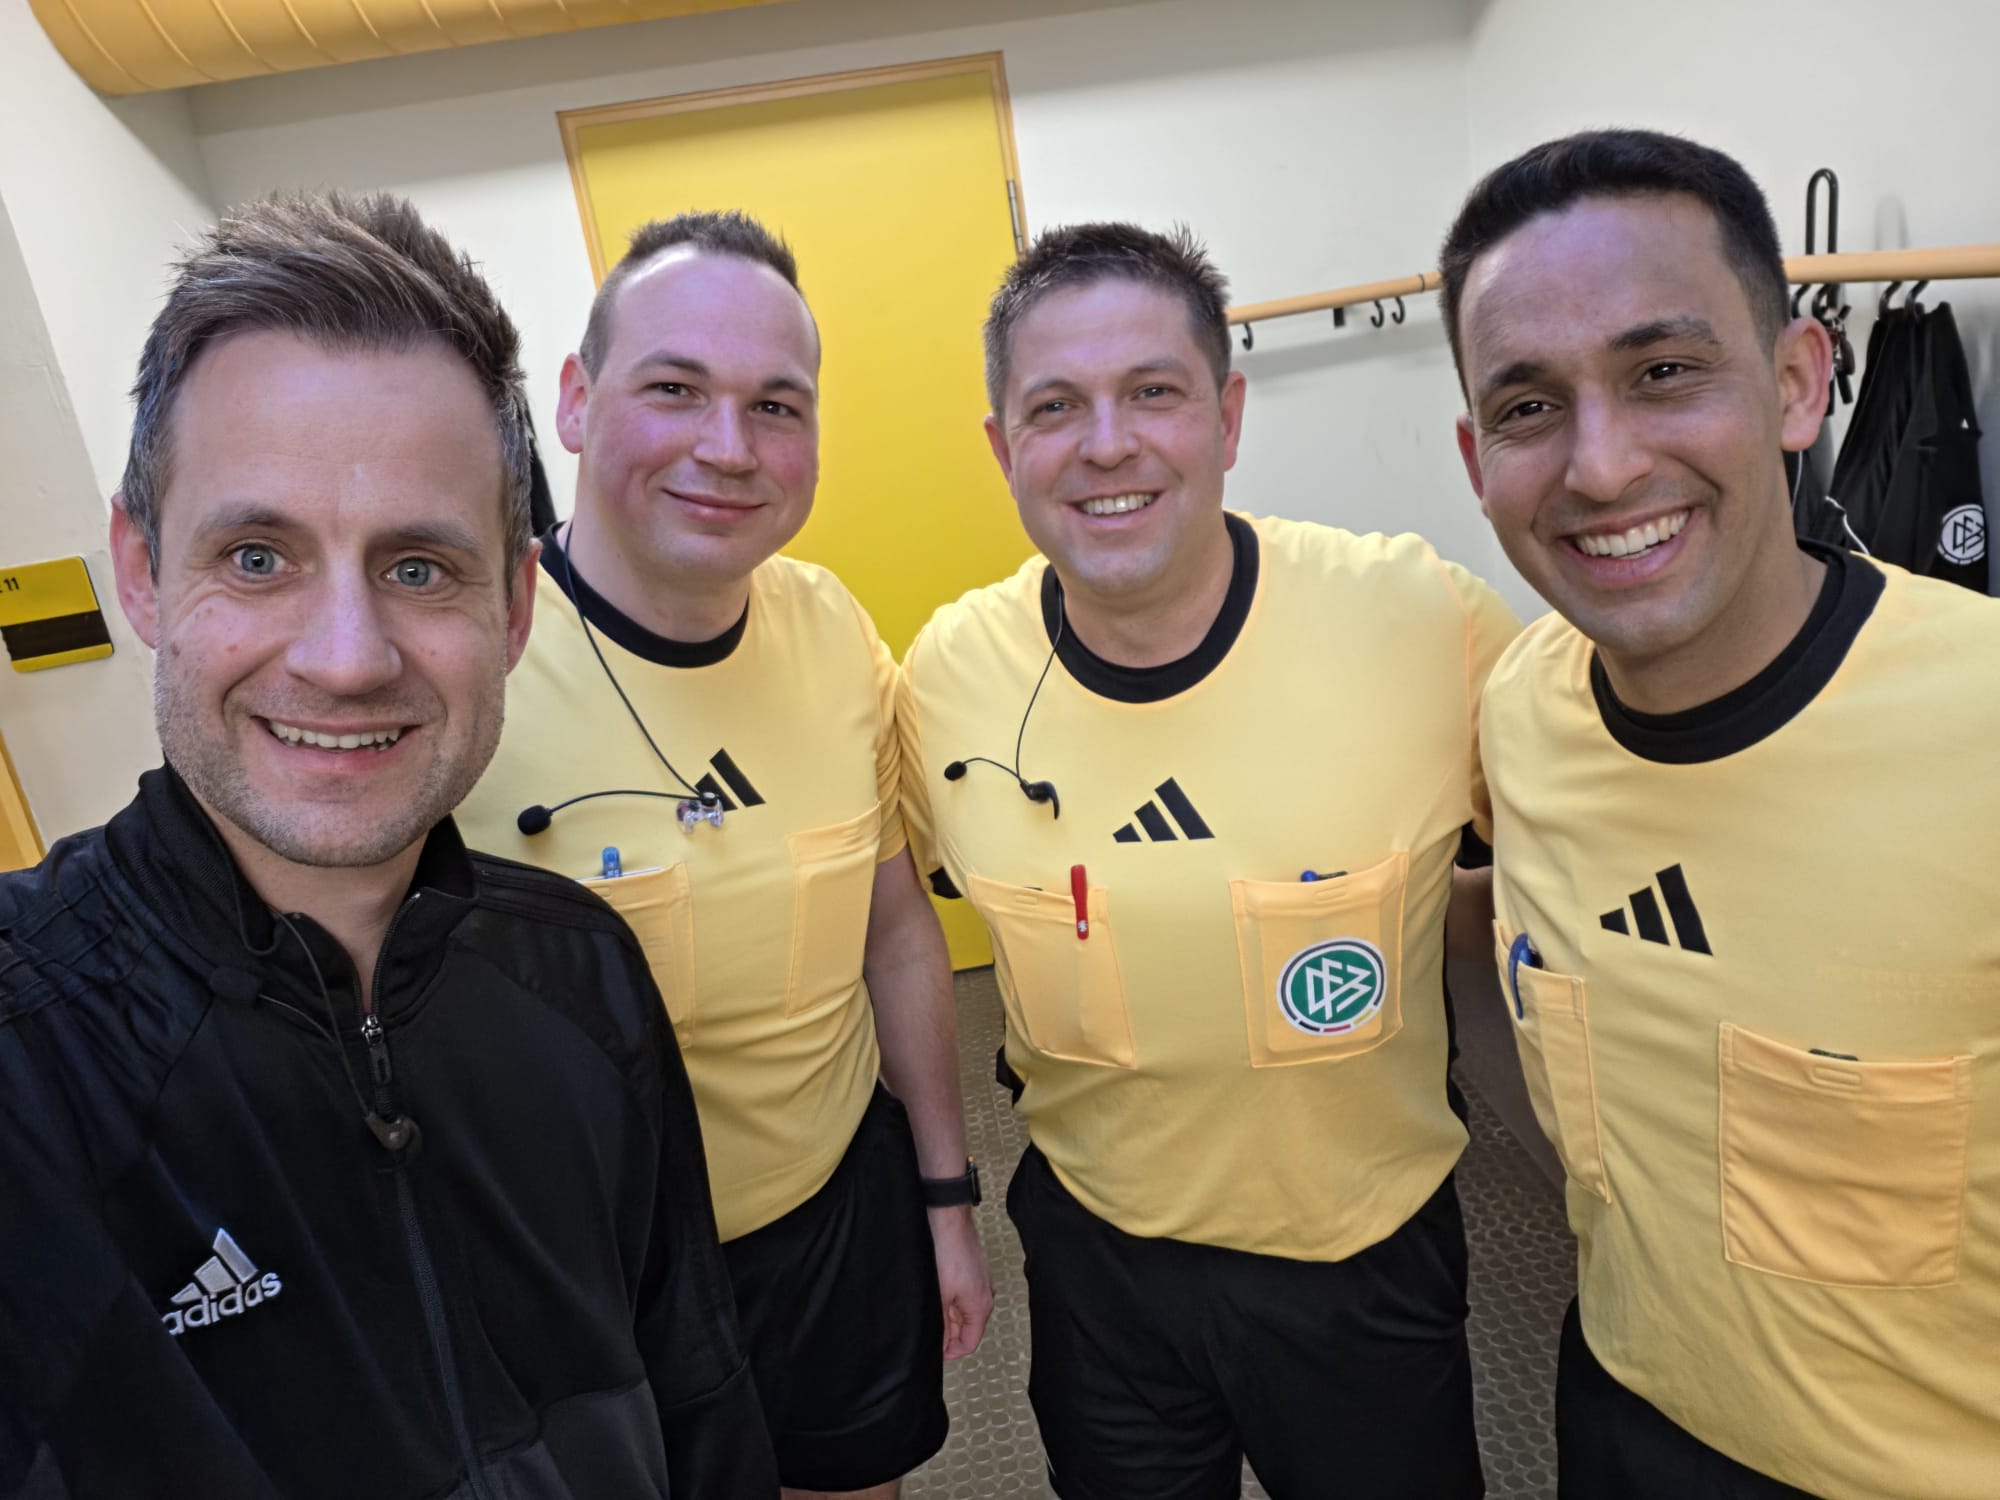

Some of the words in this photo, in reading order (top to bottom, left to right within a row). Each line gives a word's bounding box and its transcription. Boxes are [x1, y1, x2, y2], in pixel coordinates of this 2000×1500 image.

[3, 577, 20, 591] 11
[1305, 957, 1373, 1021] DFB
[161, 1272, 282, 1335] adidas
